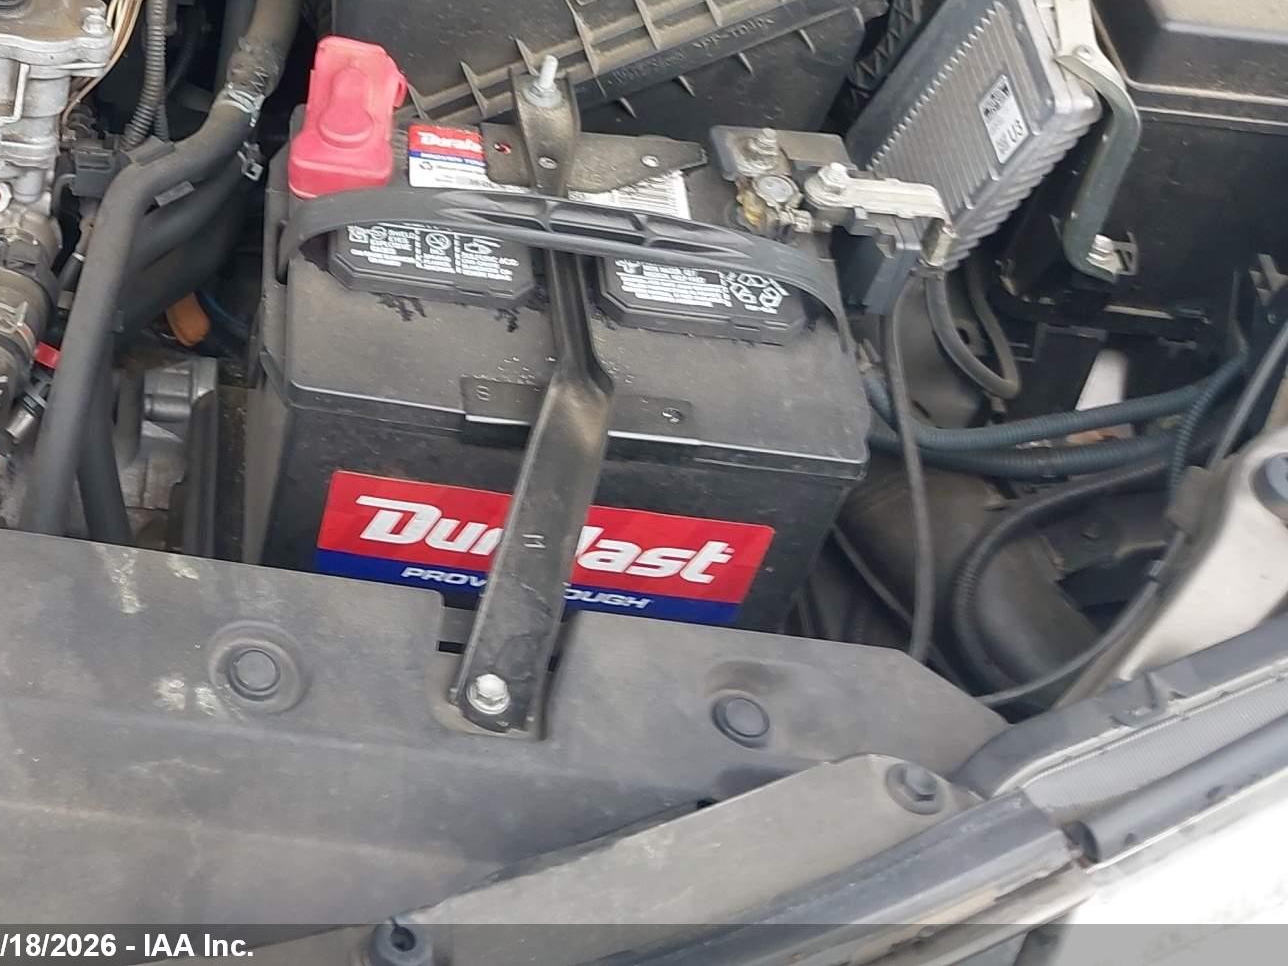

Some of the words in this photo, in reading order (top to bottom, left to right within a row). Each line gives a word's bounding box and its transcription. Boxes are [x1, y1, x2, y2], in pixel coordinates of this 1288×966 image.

[355, 495, 735, 584] Durlast
[400, 566, 488, 587] PROV
[562, 588, 653, 609] OUGH
